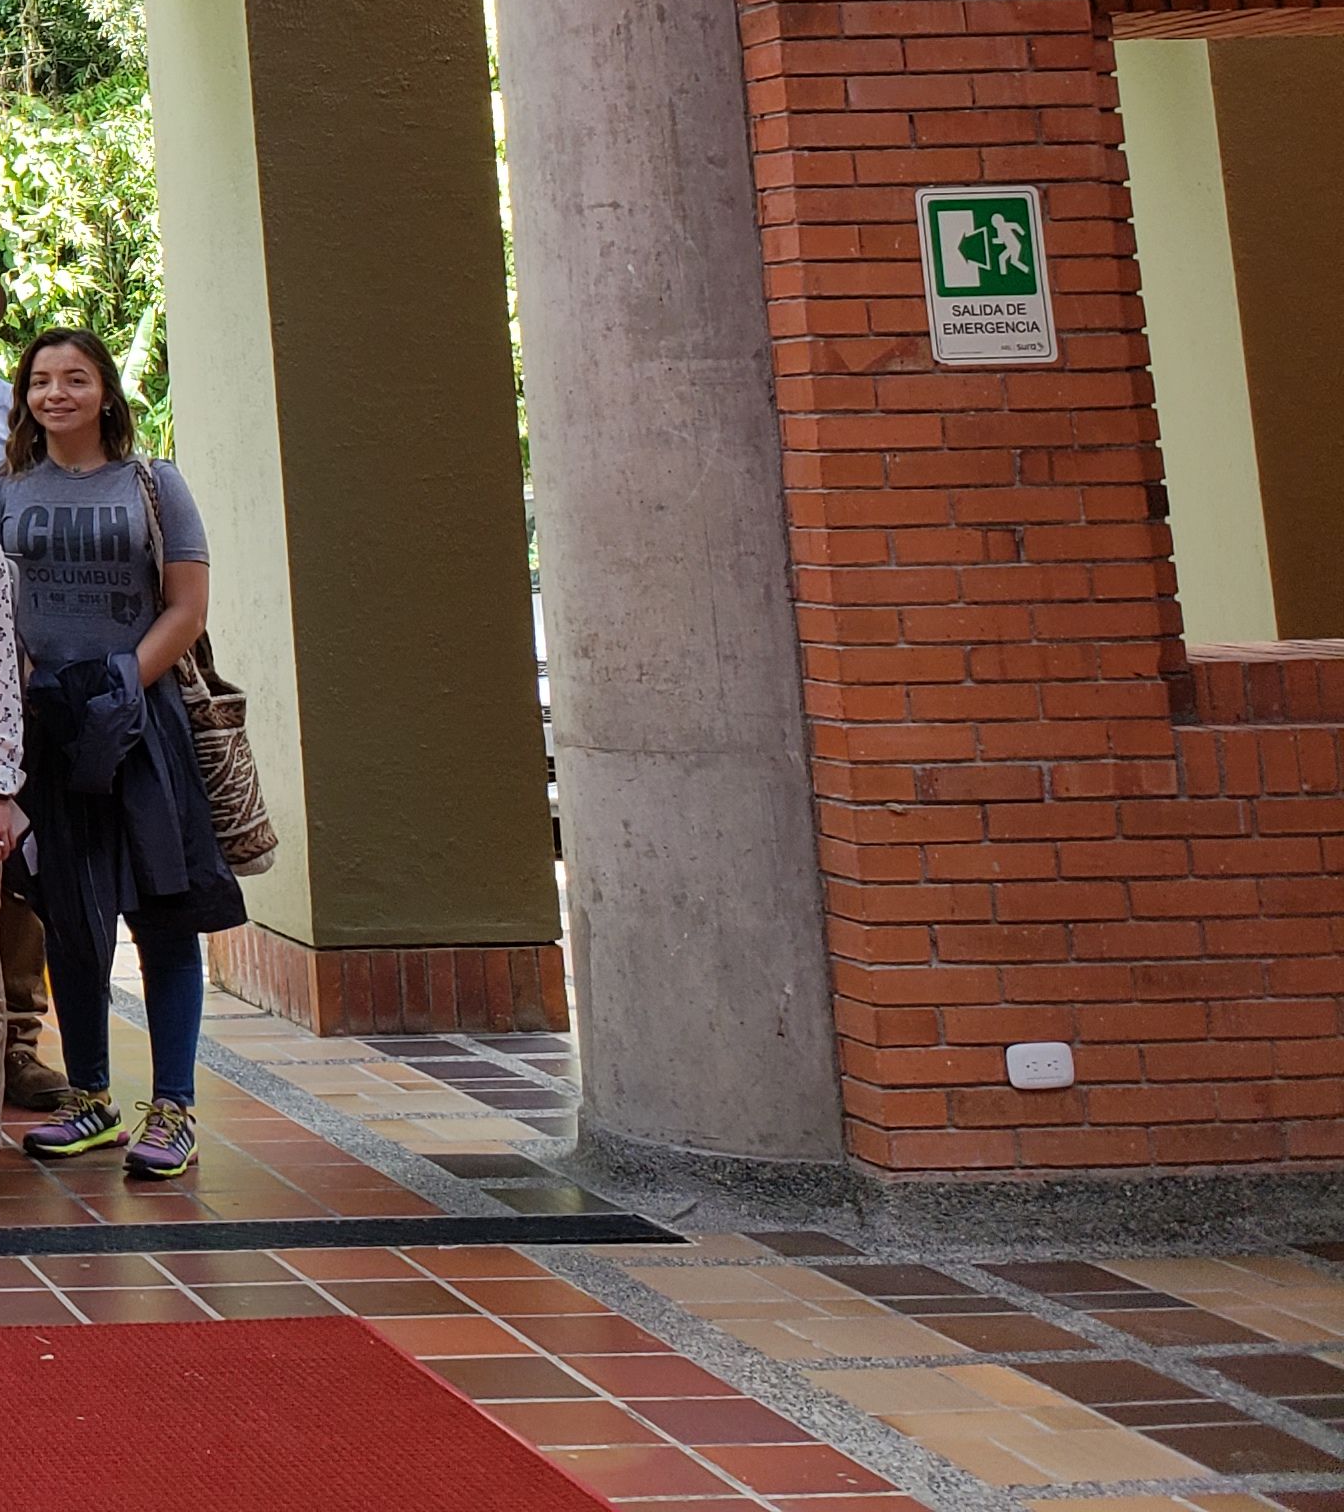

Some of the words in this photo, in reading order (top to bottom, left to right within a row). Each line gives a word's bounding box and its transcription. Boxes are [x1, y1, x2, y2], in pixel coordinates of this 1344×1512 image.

[951, 303, 1004, 317] SALIDA
[1006, 302, 1027, 316] DE
[942, 320, 1041, 336] EMERGENCIA
[17, 505, 131, 563] CMH
[26, 568, 132, 586] COLUMBUS
